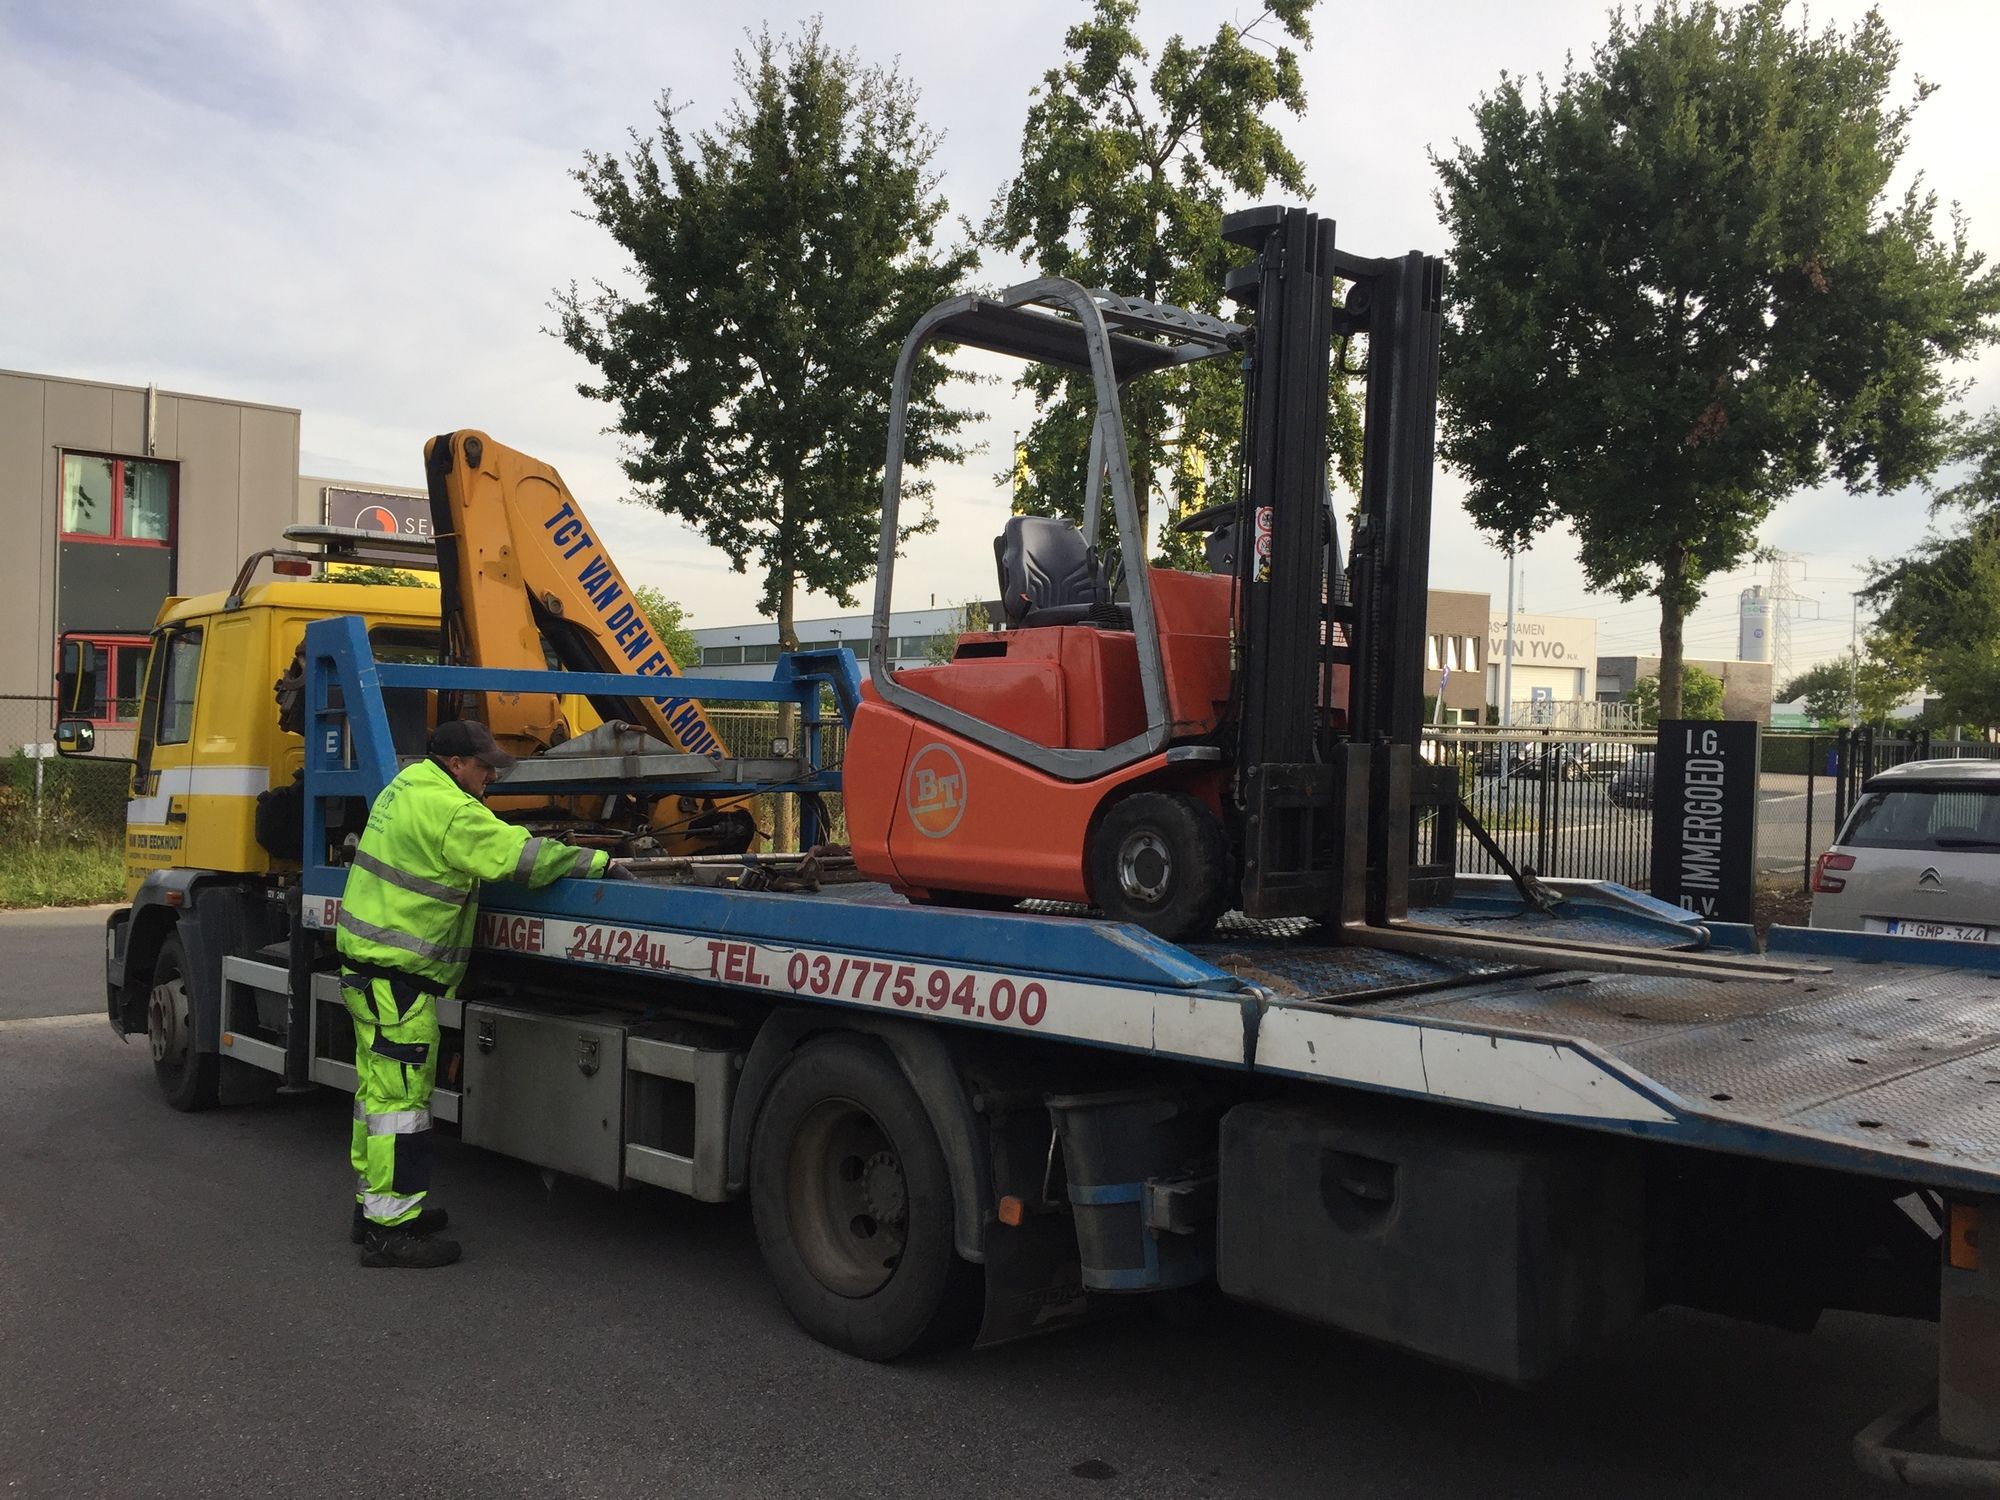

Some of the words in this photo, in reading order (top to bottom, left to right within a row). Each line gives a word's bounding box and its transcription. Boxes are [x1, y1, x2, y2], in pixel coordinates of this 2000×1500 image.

[544, 502, 593, 561] TCT
[577, 555, 624, 612] VAN
[605, 602, 653, 662] DEN
[635, 650, 721, 757] EKHOU
[1530, 641, 1565, 660] YVO
[1685, 729, 1725, 756] I.G.
[915, 768, 960, 809] BT
[1681, 758, 1725, 890] IMMERGOED
[476, 914, 543, 953] NAGE
[707, 941, 770, 986] TEL.
[787, 952, 1048, 1027] 03/775.94.00
